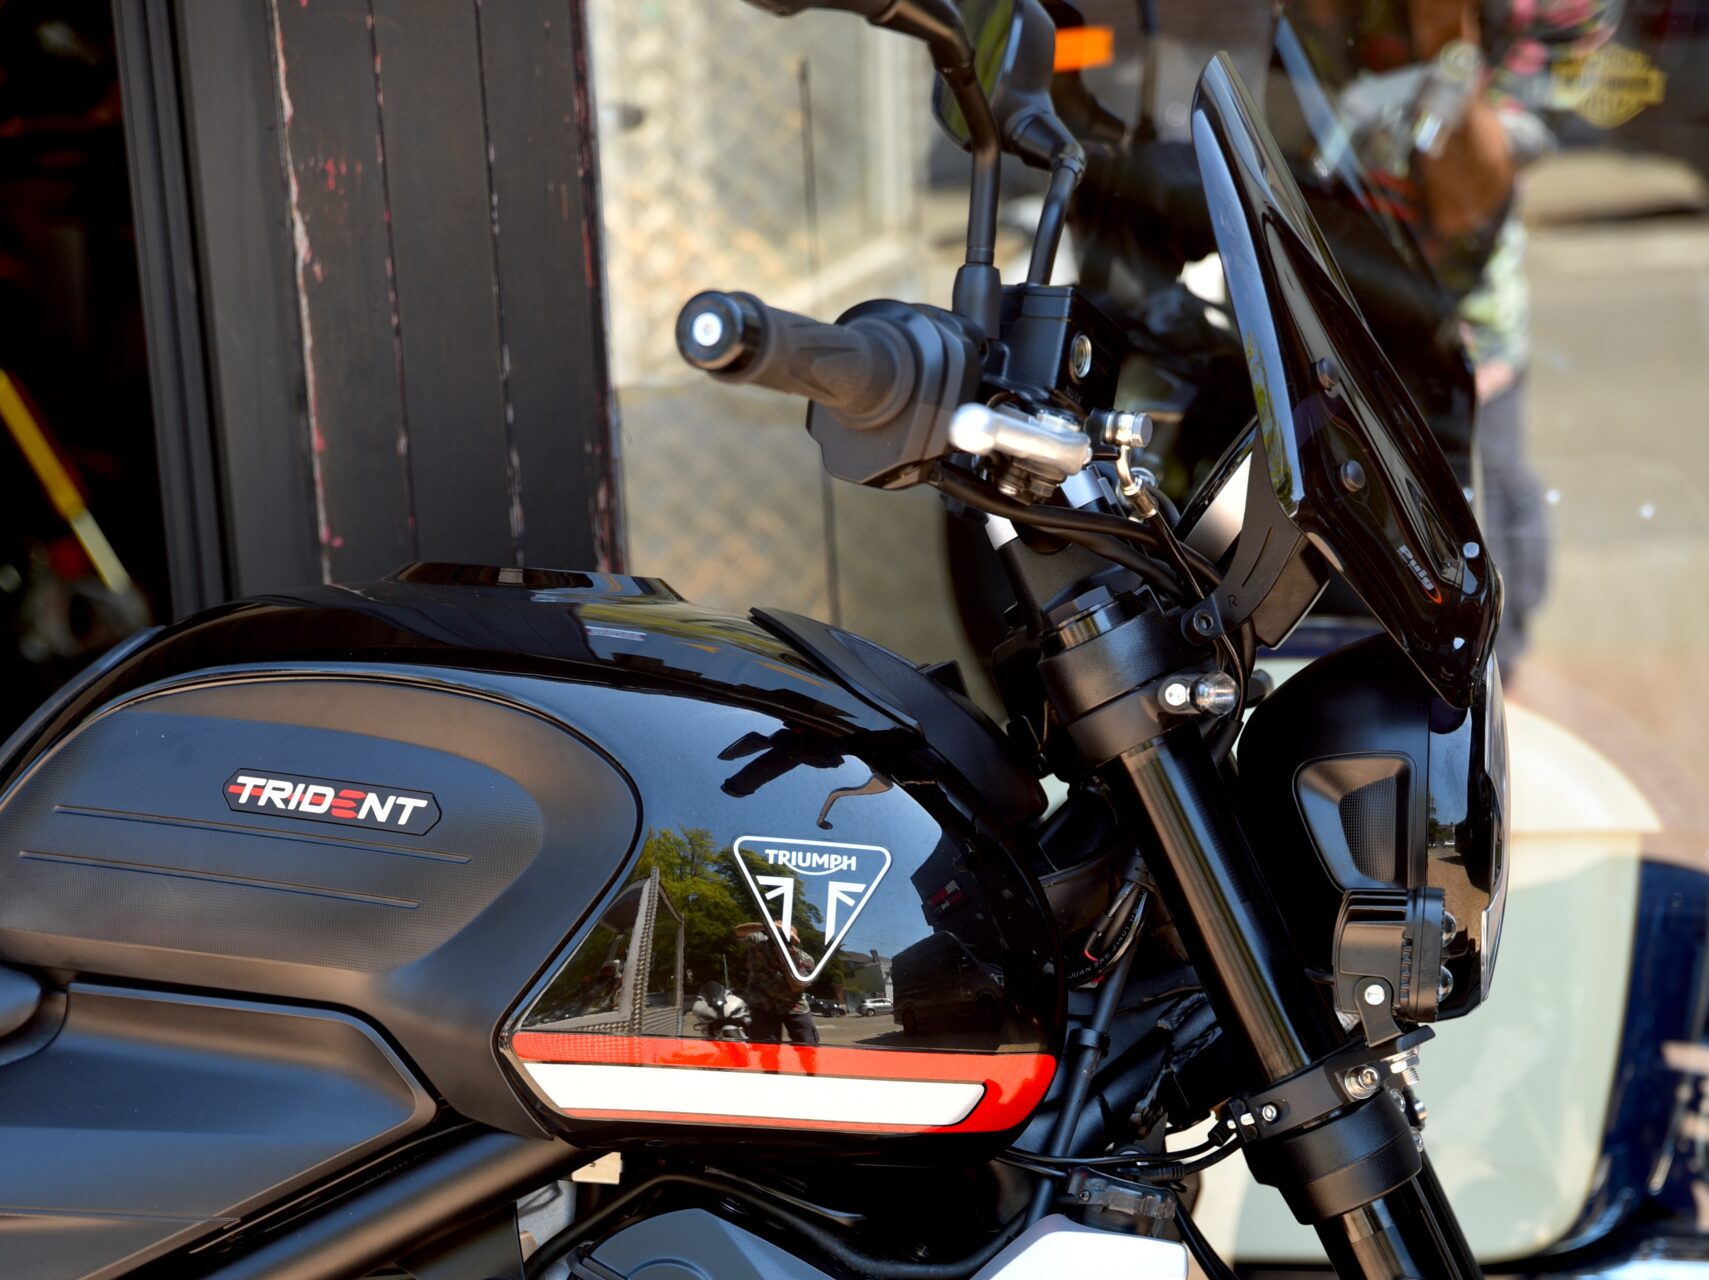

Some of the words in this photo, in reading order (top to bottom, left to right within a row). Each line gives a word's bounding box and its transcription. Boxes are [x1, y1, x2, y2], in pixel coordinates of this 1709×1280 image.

[1397, 544, 1435, 591] Puig
[235, 775, 428, 826] TRIDENT
[764, 849, 857, 875] TRIUMPH
